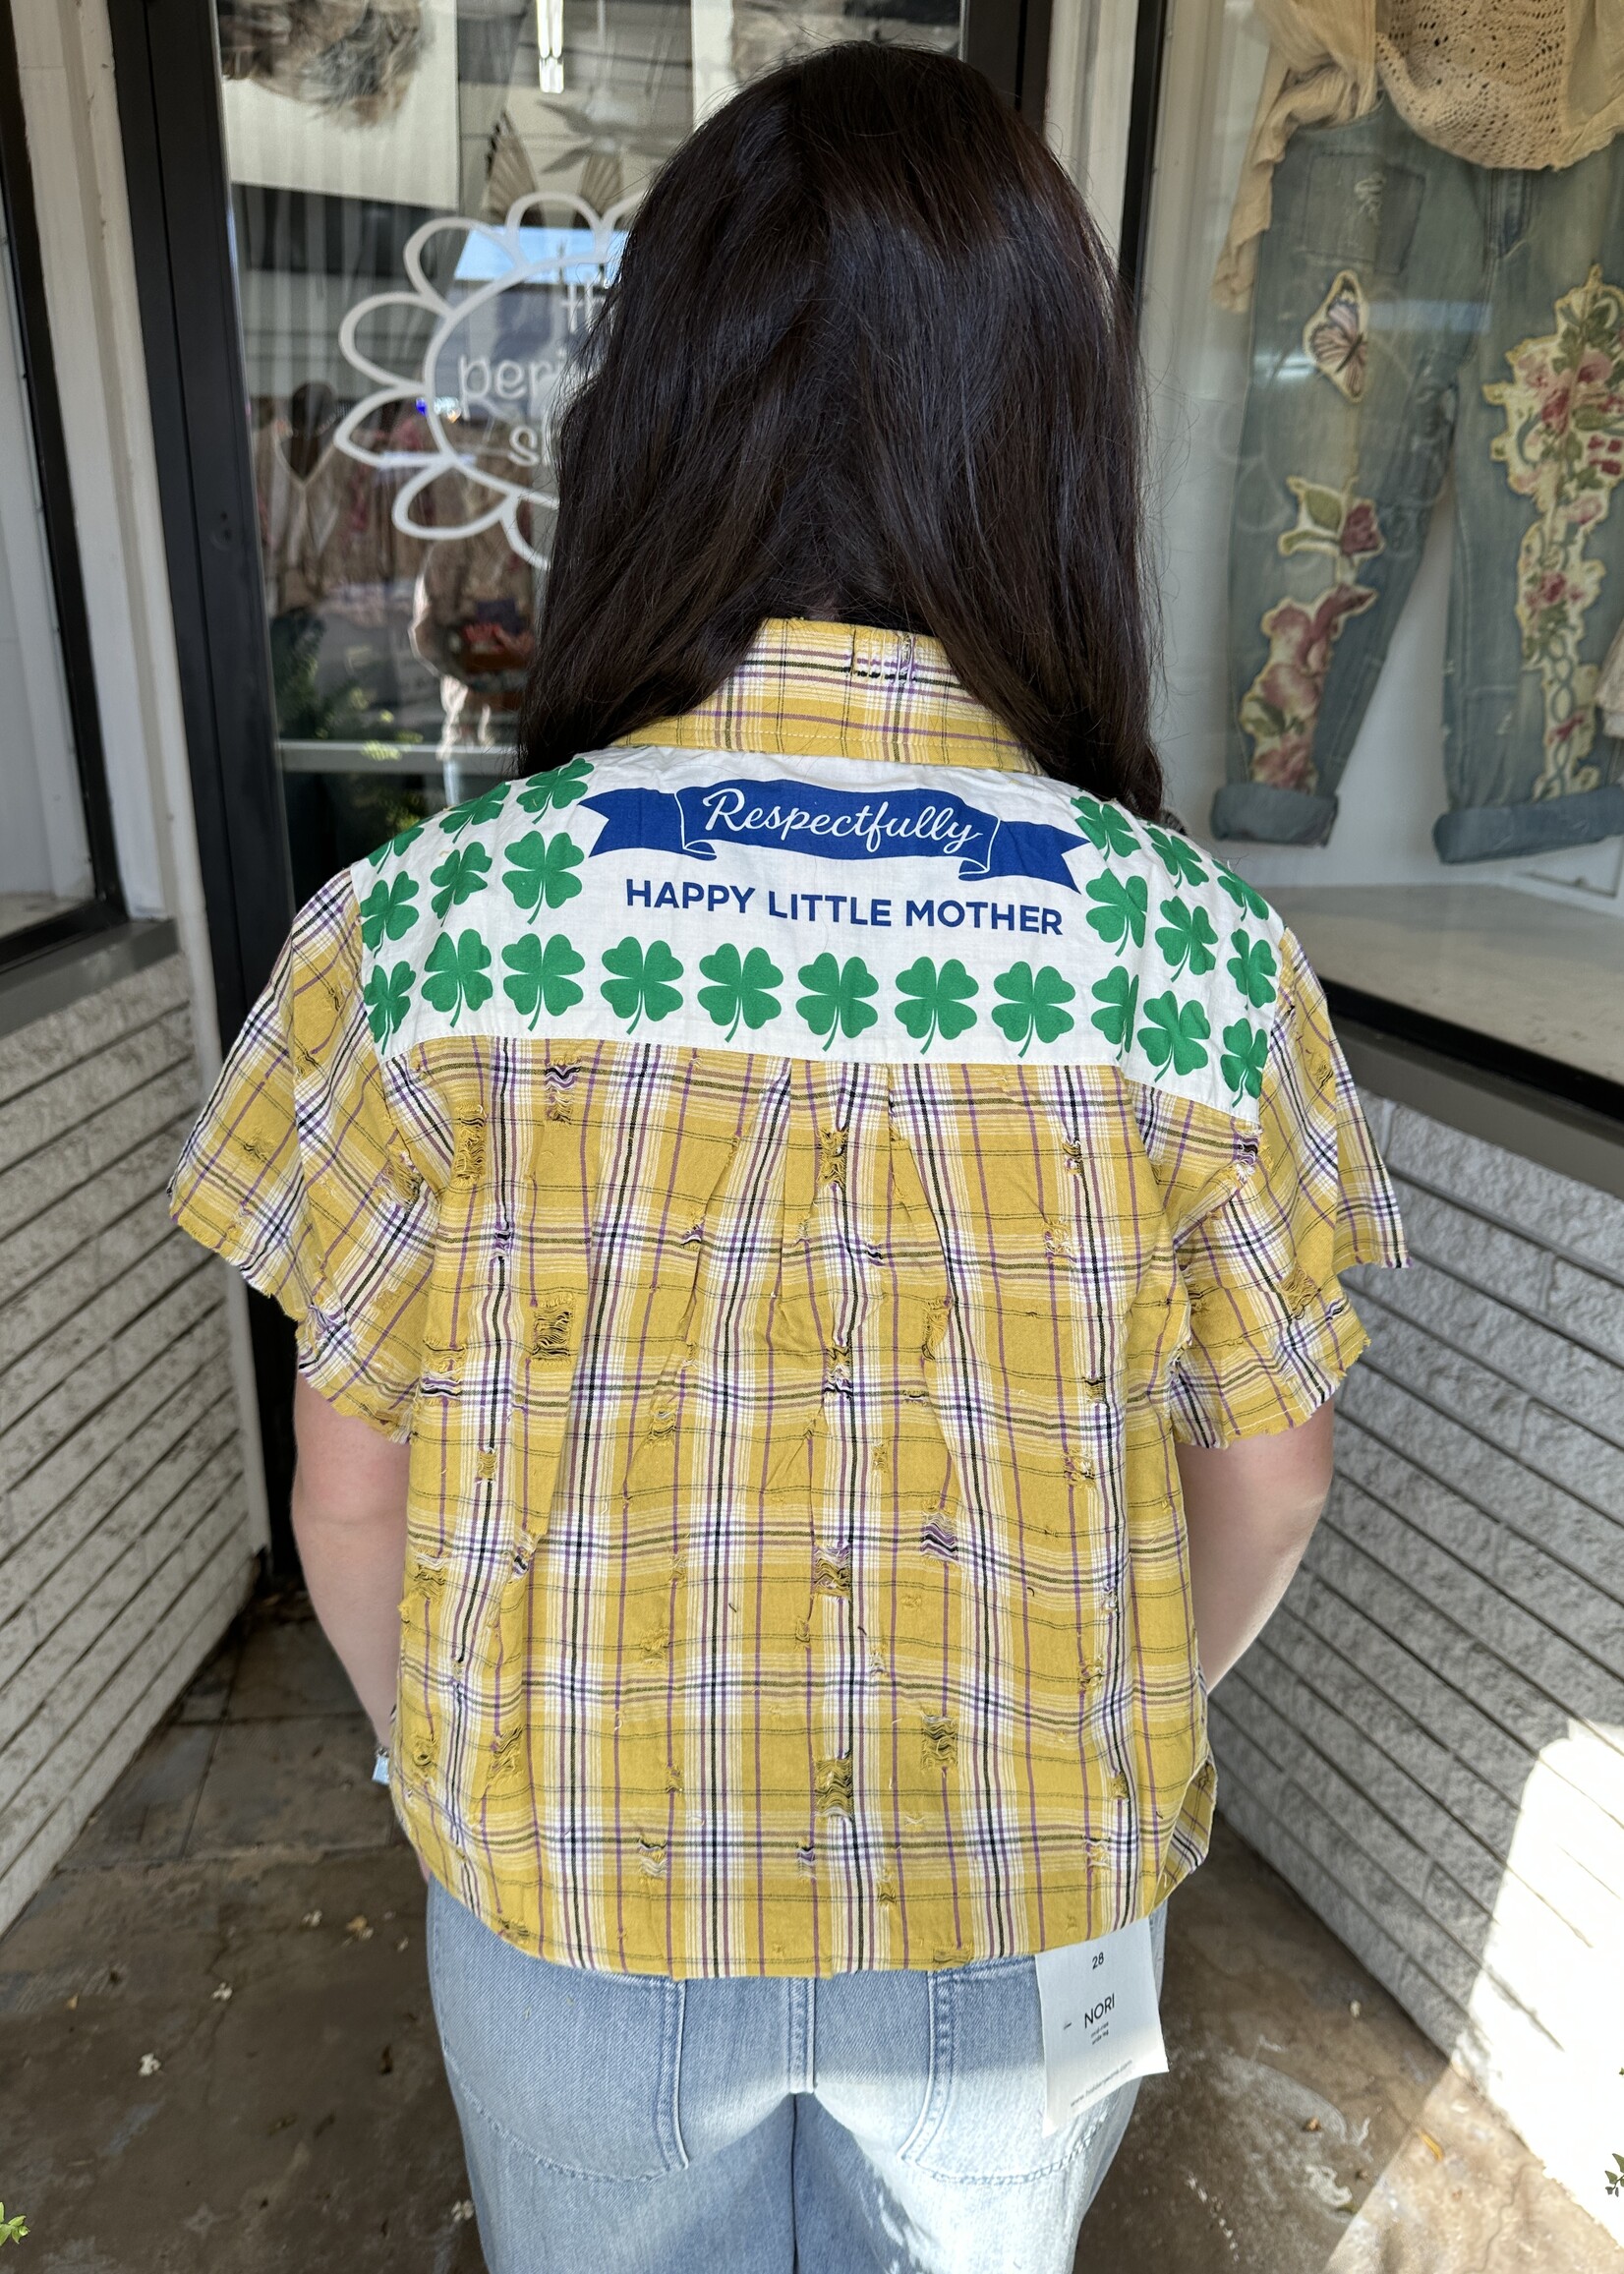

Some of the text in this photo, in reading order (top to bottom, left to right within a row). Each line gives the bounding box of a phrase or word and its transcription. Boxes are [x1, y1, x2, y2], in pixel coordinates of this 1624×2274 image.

[702, 787, 983, 853] Respectfully
[626, 878, 1064, 936] HAPPY LITTLE MOTHER
[1092, 1952, 1105, 1970] 28
[1084, 1992, 1115, 2029] NORI
